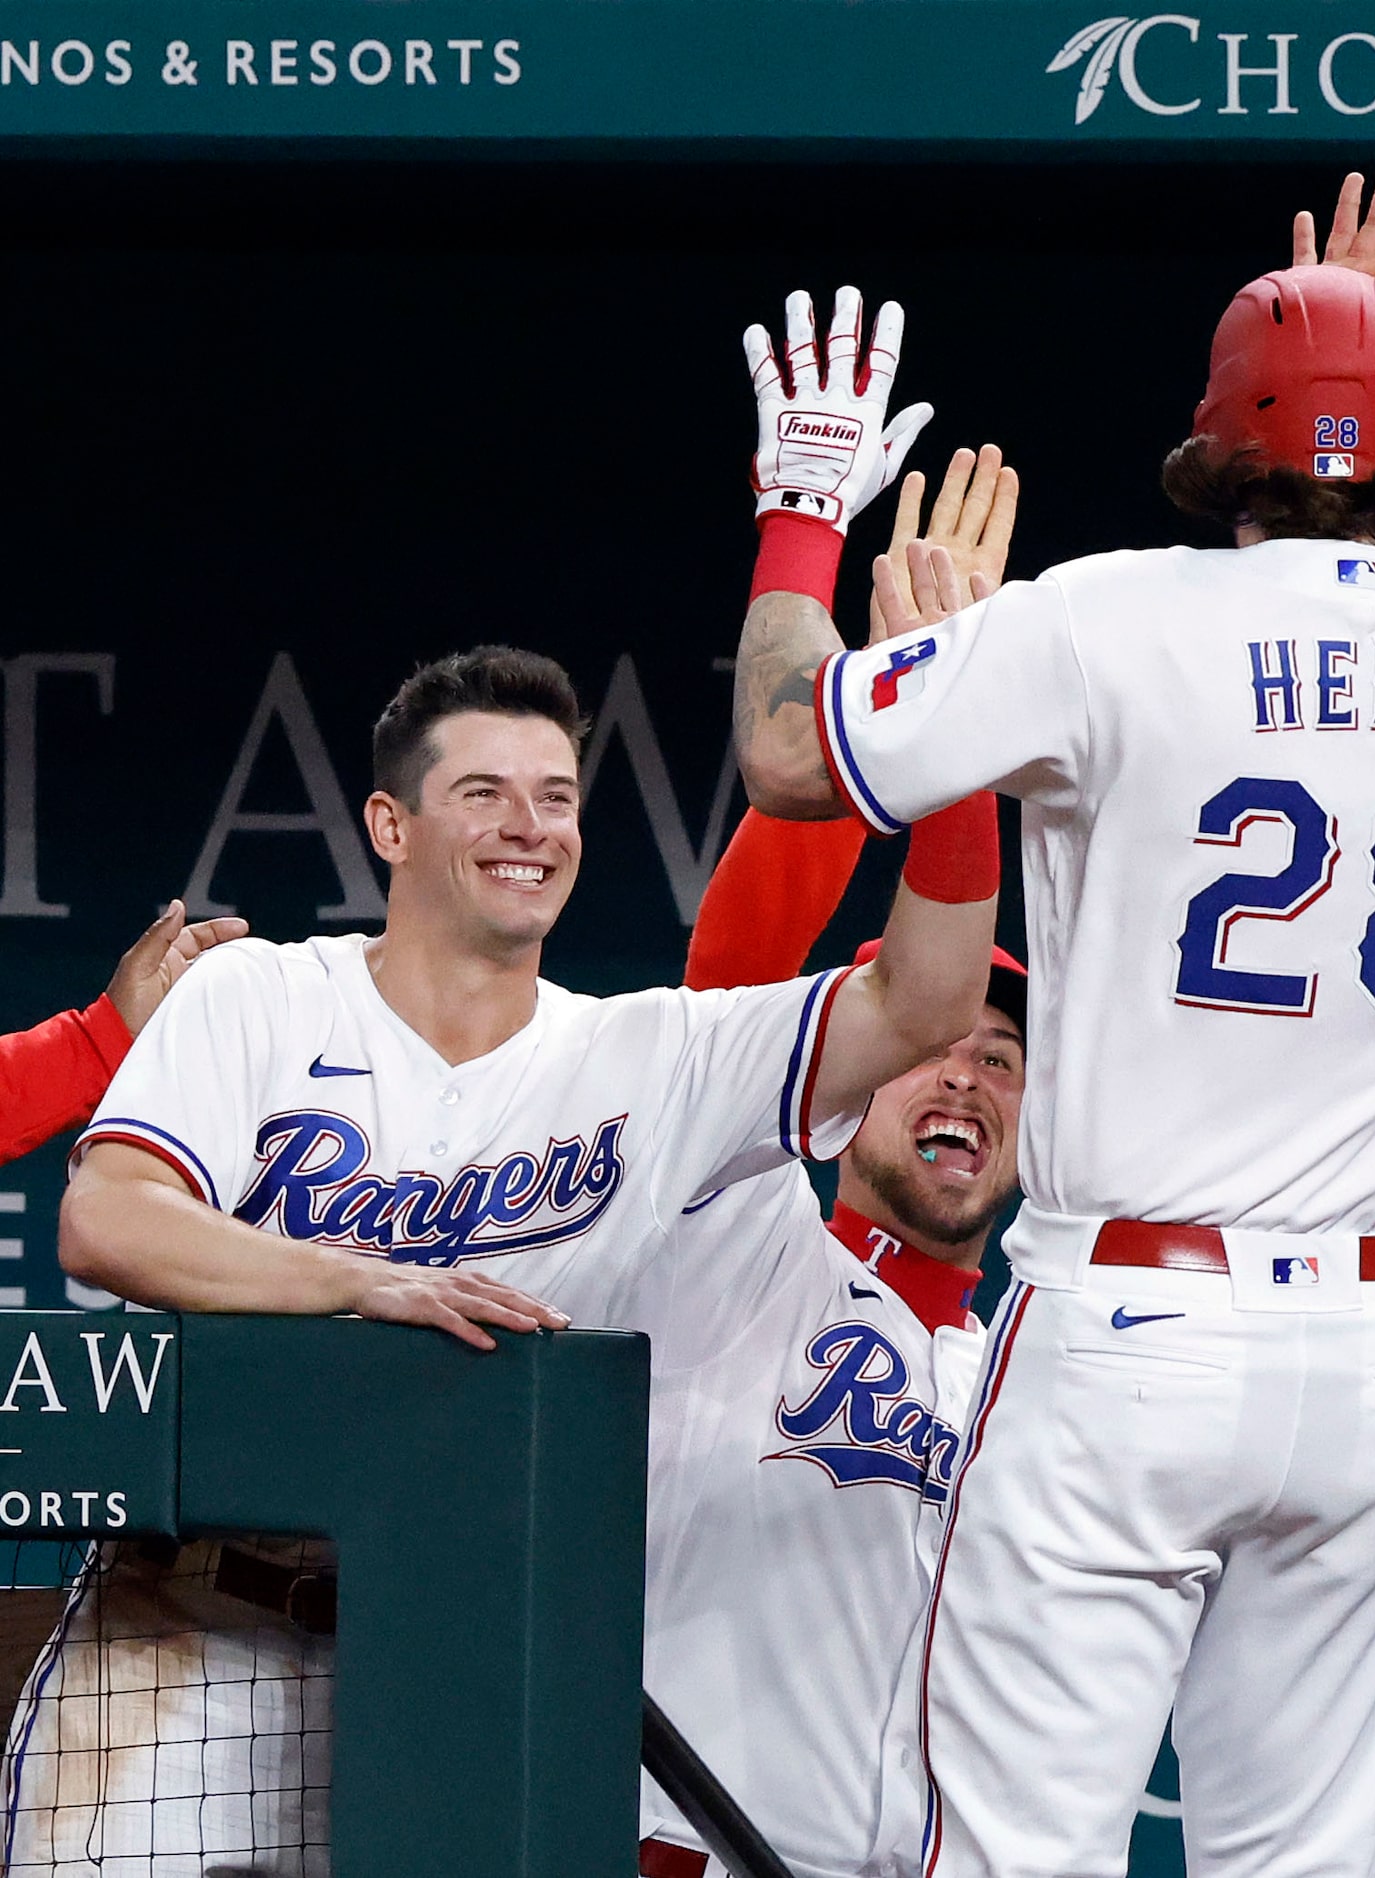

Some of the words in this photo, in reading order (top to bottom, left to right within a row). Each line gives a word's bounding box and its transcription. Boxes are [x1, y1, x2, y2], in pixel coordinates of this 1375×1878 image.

[0, 40, 132, 85] NOS
[162, 40, 198, 85] &
[227, 39, 521, 85] RESORTS
[1314, 415, 1360, 449] 28
[232, 1108, 629, 1268] Rangers
[863, 1226, 902, 1277] T
[0, 1331, 175, 1414] AW
[0, 1490, 128, 1528] ORTS
